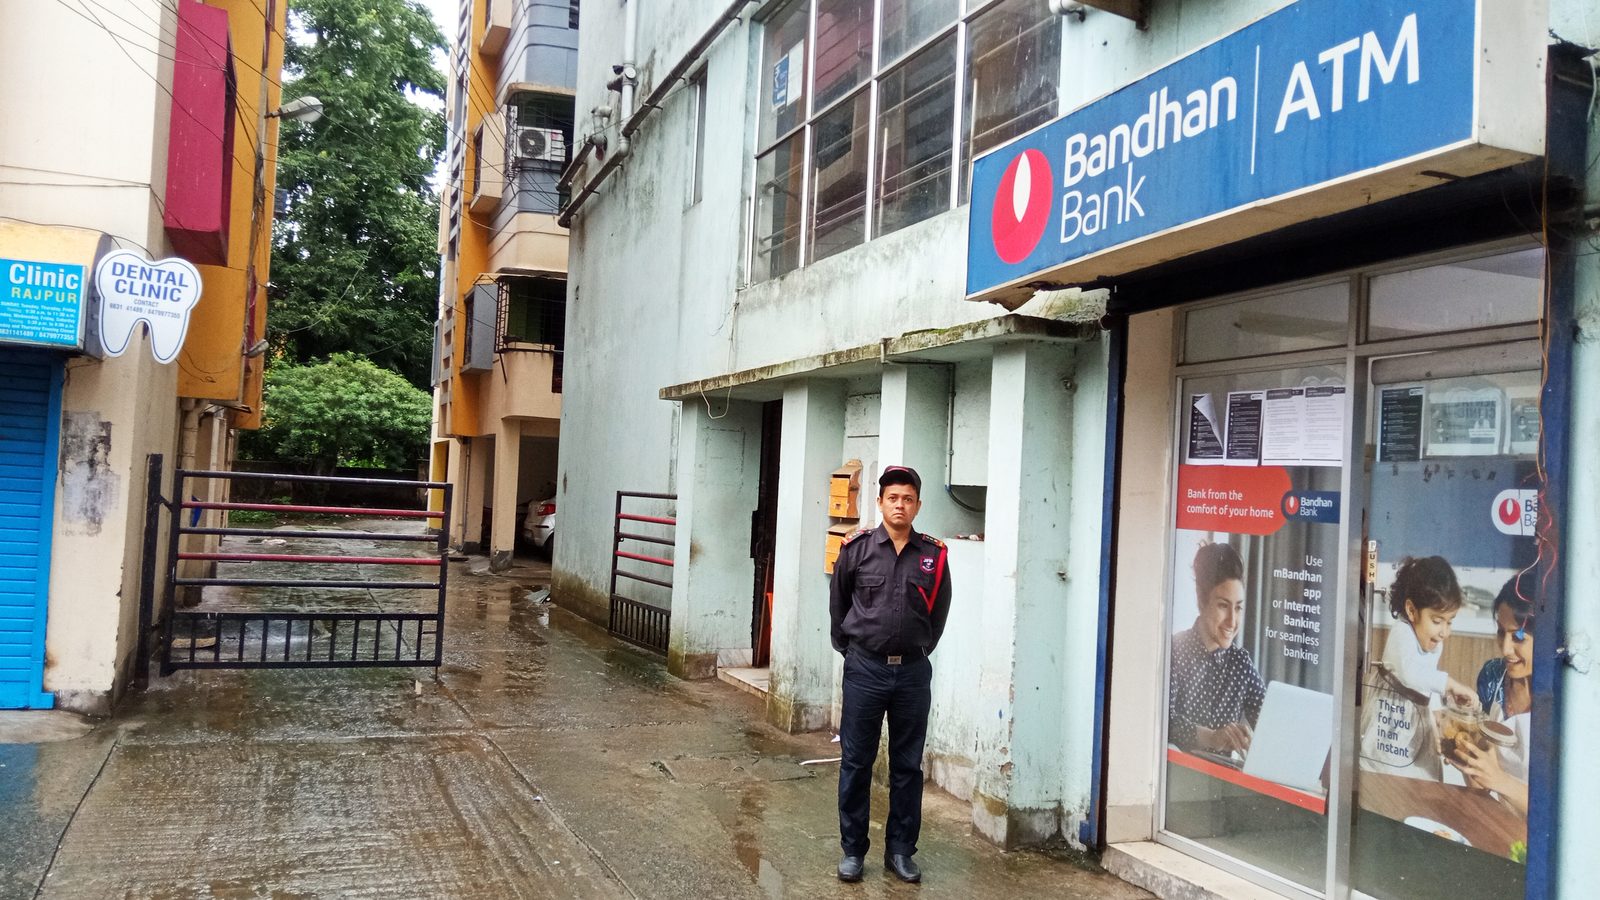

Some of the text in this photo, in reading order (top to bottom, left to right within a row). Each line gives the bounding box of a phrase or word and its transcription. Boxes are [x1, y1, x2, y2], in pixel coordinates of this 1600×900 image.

[1275, 12, 1421, 135] ATM
[1062, 75, 1238, 187] Bandhan
[1059, 162, 1146, 244] Bank
[9, 263, 79, 290] Clinic
[111, 261, 189, 288] DENTAL
[11, 286, 77, 304] RAJPUR
[114, 278, 182, 303] CLINIC
[133, 299, 159, 308] CONTACT
[1187, 488, 1243, 501] Bank from the
[1300, 496, 1333, 508] Bandhan
[1186, 503, 1274, 518] comfort of your home
[1300, 507, 1318, 516] Bank
[1305, 554, 1323, 567] Use
[1273, 568, 1322, 583] mBandhan
[1303, 588, 1322, 600] app
[1272, 599, 1321, 615] or Internet
[1283, 614, 1320, 633] Banking
[1265, 626, 1319, 647] for seamless
[1283, 645, 1319, 665] banking
[1378, 698, 1405, 714] There
[1378, 711, 1410, 730] for you
[1377, 725, 1398, 741] in an
[1377, 738, 1409, 758] instant
